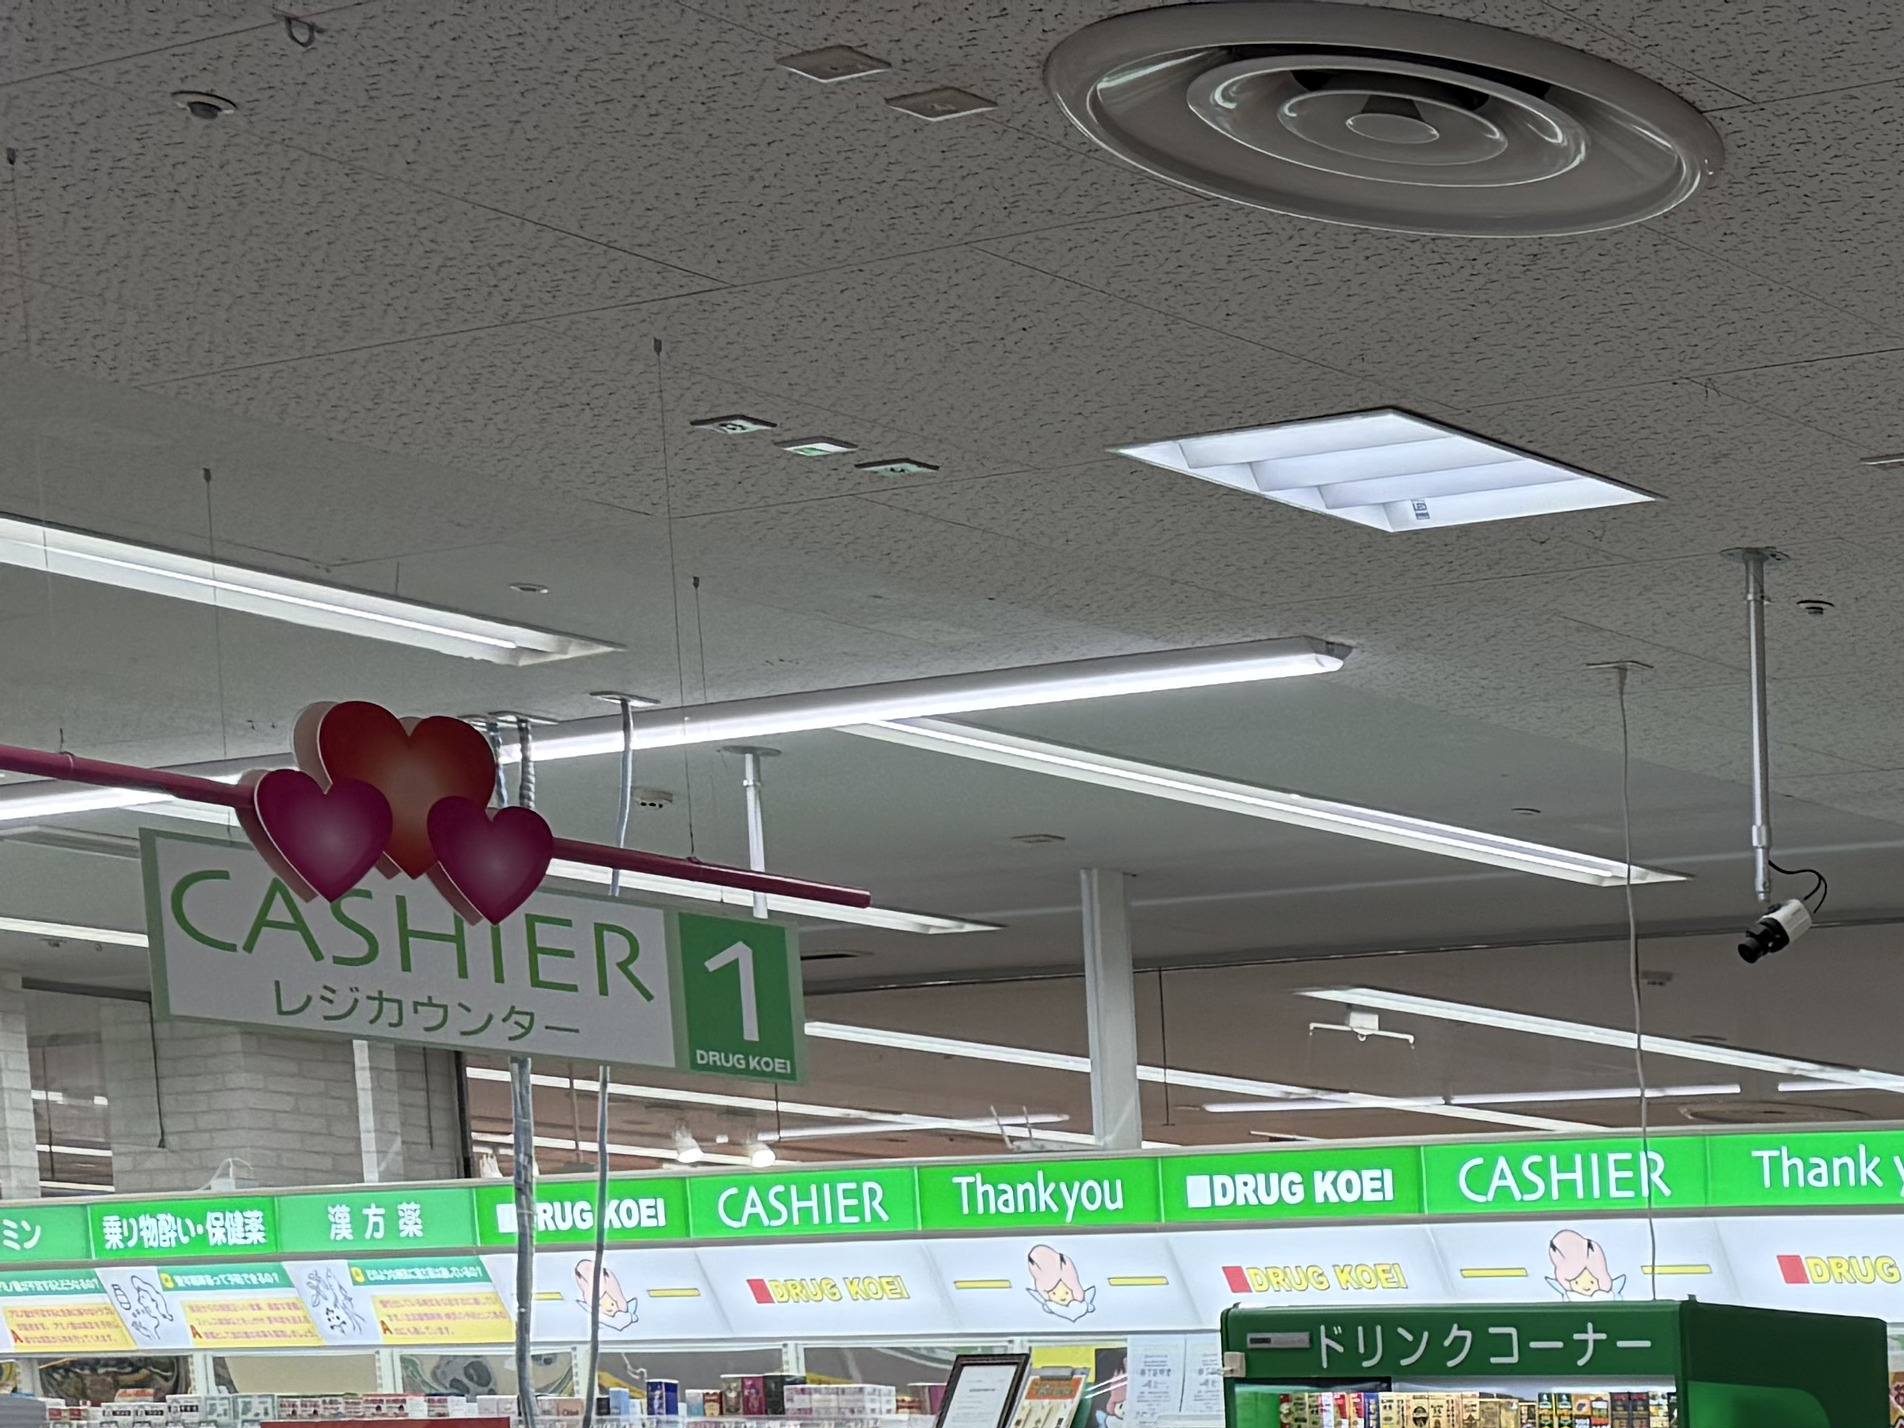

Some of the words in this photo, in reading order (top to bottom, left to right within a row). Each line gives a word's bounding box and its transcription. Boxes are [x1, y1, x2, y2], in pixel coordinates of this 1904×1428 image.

[170, 868, 656, 1003] CASHIER
[274, 978, 581, 1043] レジカウンター
[703, 939, 760, 1043] 1
[696, 1050, 747, 1071] DRUG
[749, 1055, 792, 1074] KOEI
[1212, 1170, 1306, 1205] DRUG
[1314, 1169, 1394, 1202] KOEI
[1458, 1151, 1672, 1203] CASHIER
[1752, 1148, 1882, 1190] Thank
[327, 1202, 424, 1241] 漢方薬
[532, 1200, 594, 1230] RUG
[602, 1196, 666, 1229] KOEI
[717, 1181, 890, 1228] CASHIER
[102, 1208, 267, 1249] 乗り物酔い・保健薬
[773, 1278, 840, 1304] DRUG
[843, 1275, 910, 1301] KOEI
[1246, 1265, 1332, 1293] DRUG
[1338, 1262, 1408, 1290] KOEI
[1804, 1256, 1901, 1286] DRUG
[1318, 1324, 1652, 1370] ドリンクコーナー
